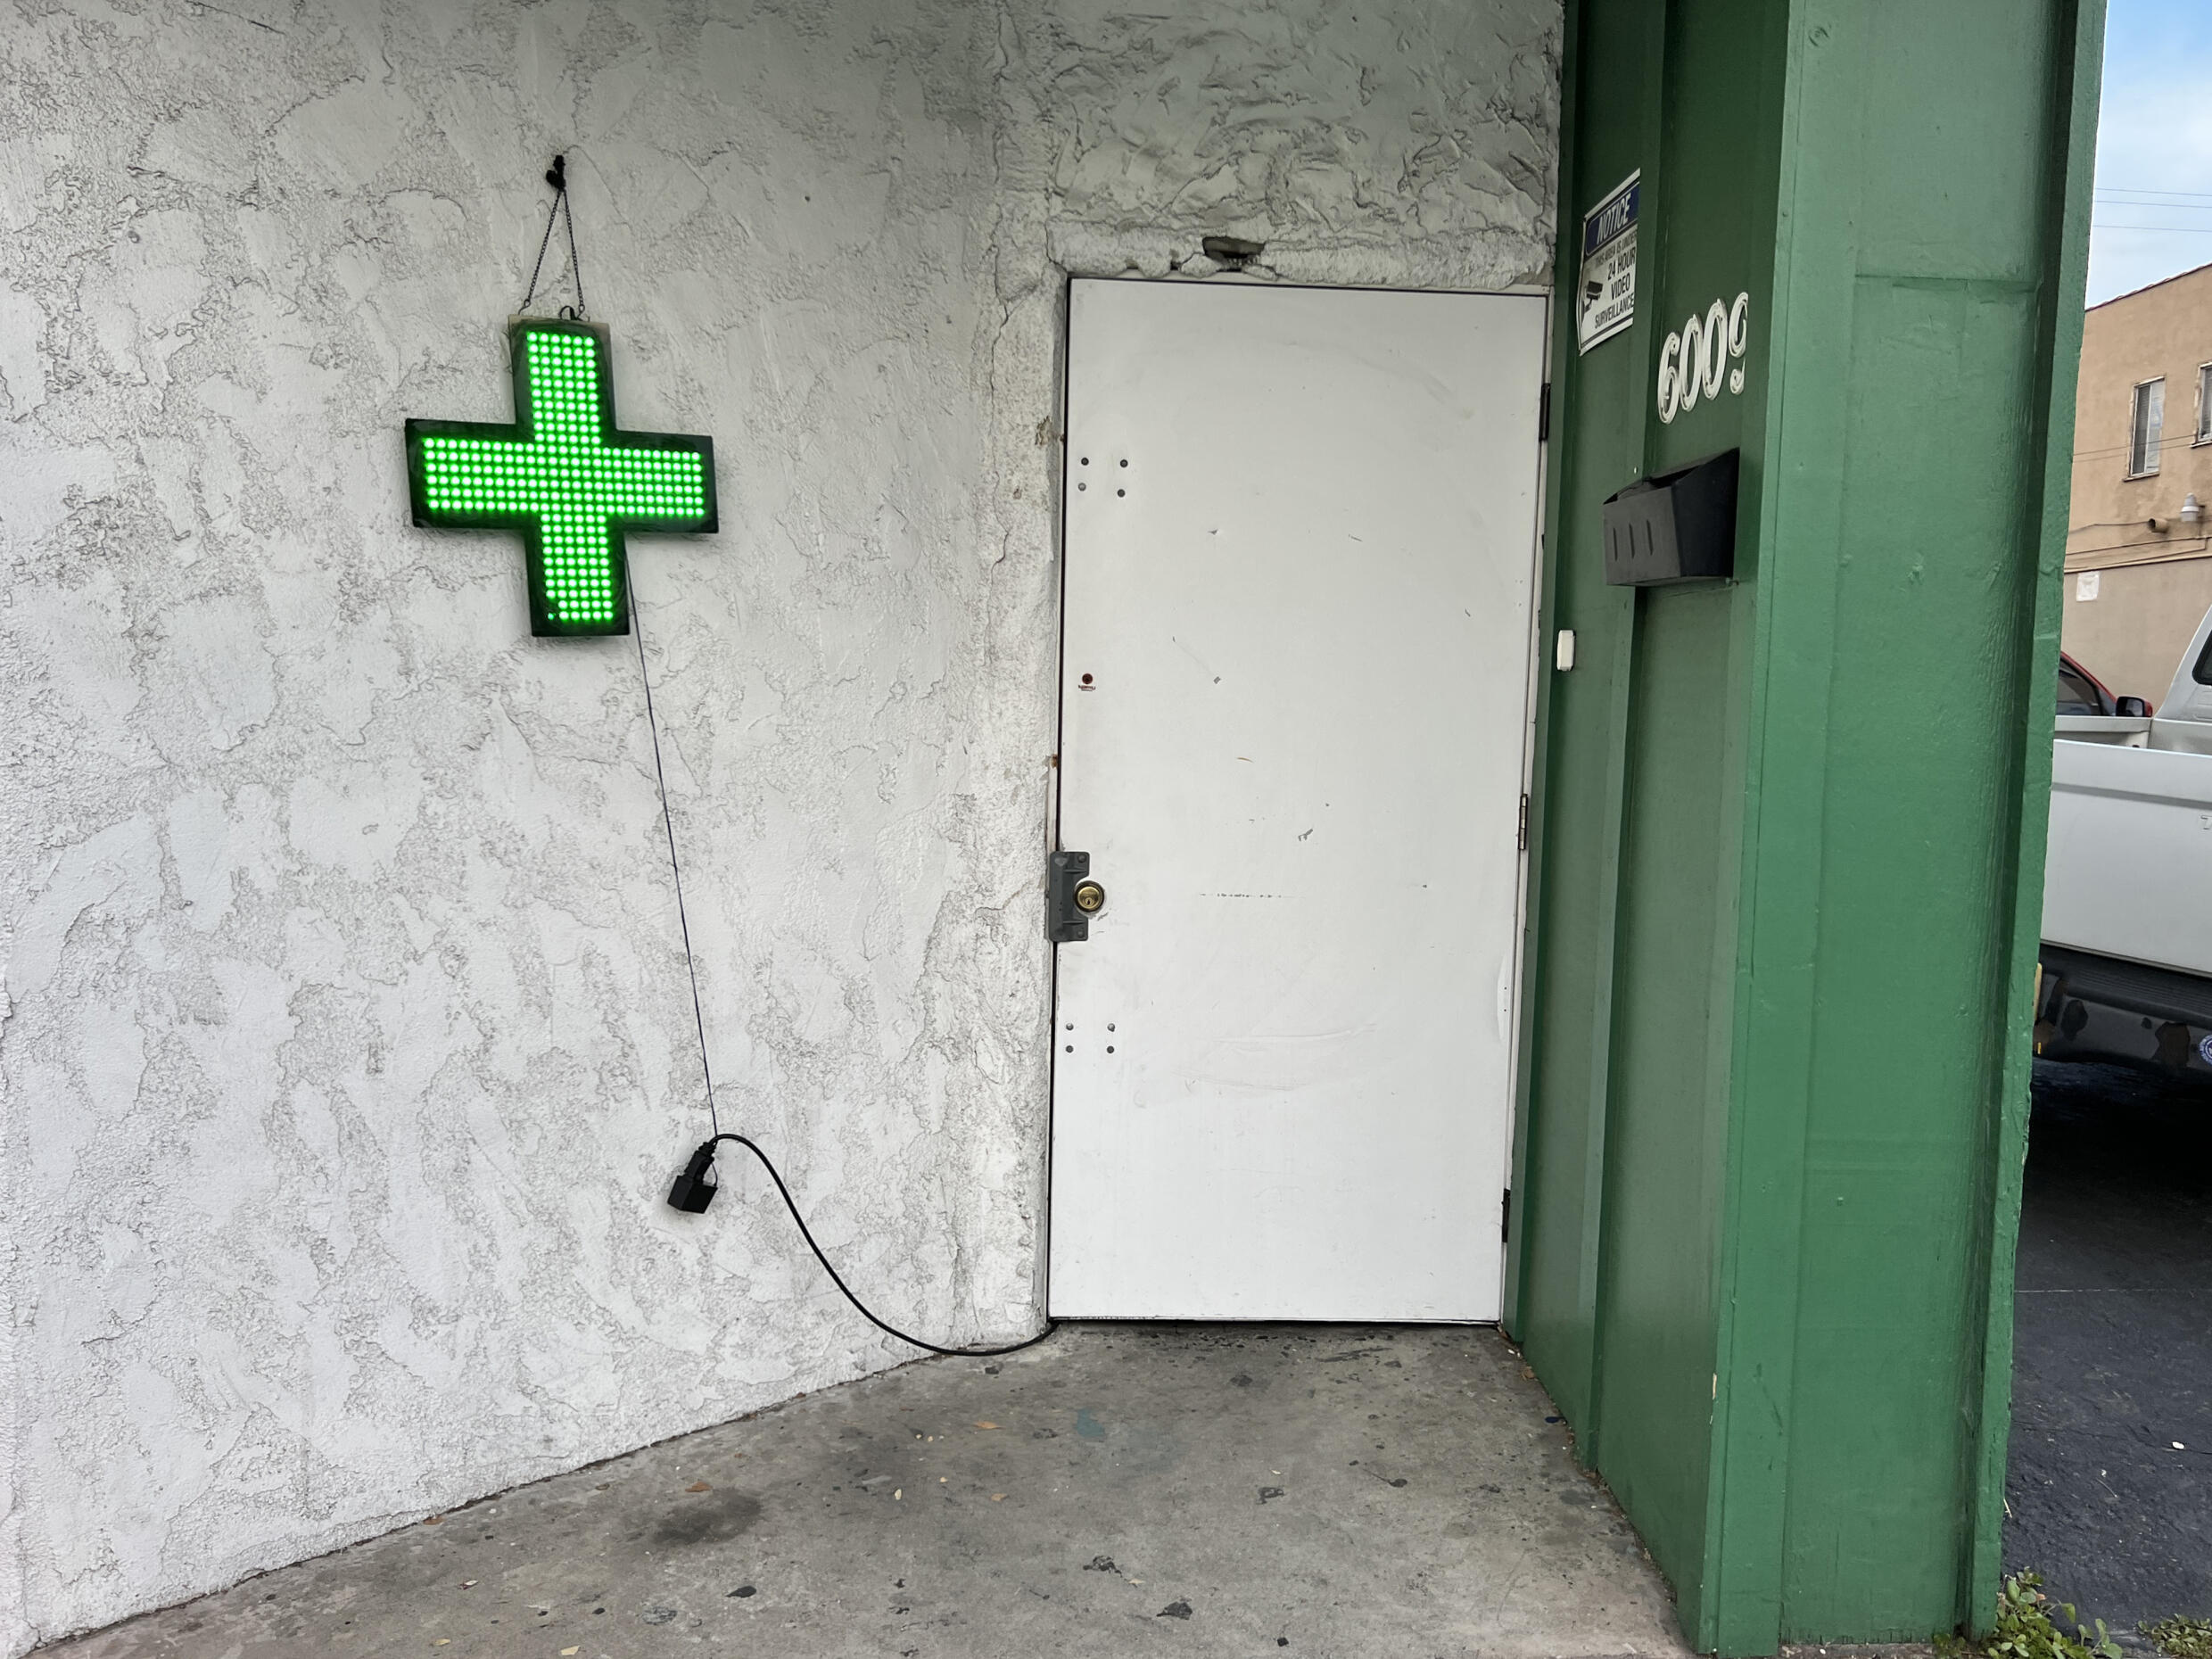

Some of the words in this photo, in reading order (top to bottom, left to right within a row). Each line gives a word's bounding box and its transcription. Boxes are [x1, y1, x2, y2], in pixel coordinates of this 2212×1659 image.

[1597, 192, 1631, 244] NOTICE
[1607, 260, 1615, 281] 24
[1617, 246, 1636, 275] HOUR
[1611, 272, 1630, 300] VIDEO
[1595, 292, 1634, 329] SURVEILLANCE
[1657, 292, 1749, 425] 6009
